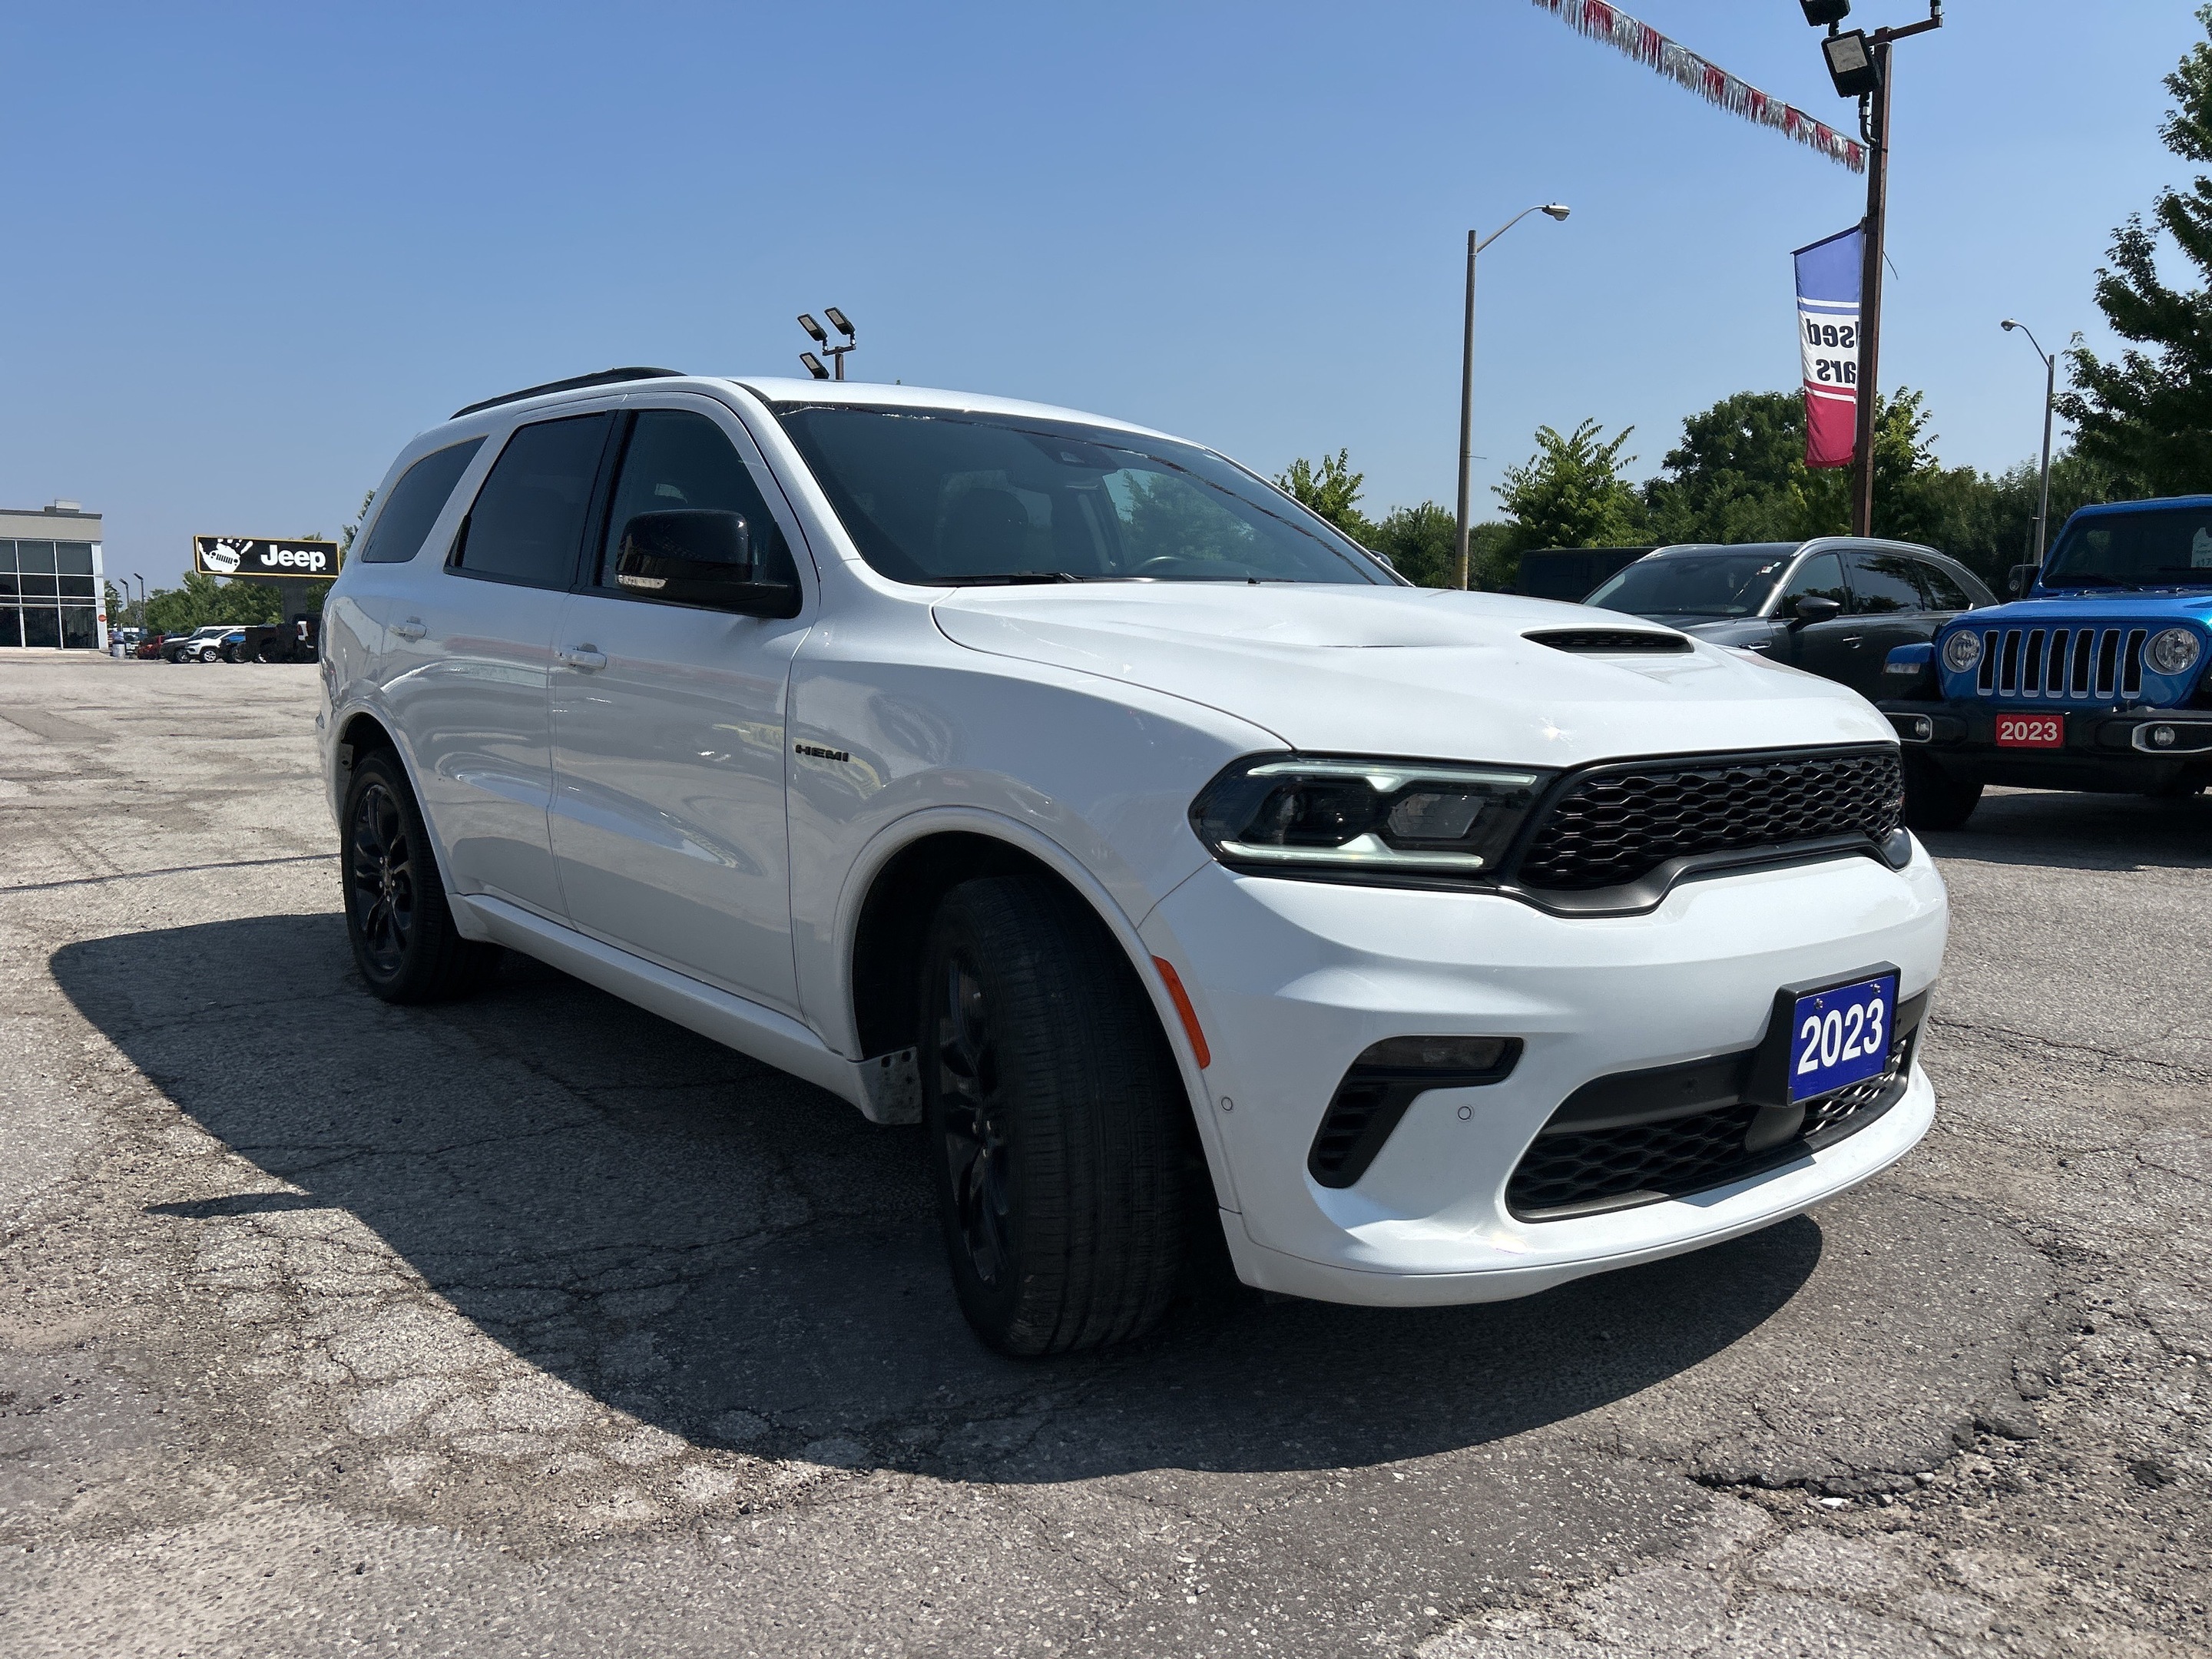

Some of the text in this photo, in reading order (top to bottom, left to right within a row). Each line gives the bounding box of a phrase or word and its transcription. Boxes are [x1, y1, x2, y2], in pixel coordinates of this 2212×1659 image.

[260, 545, 326, 571] Jeep
[2000, 721, 2058, 741] 2023
[796, 744, 849, 762] HEMI
[1797, 998, 1884, 1075] 2023
